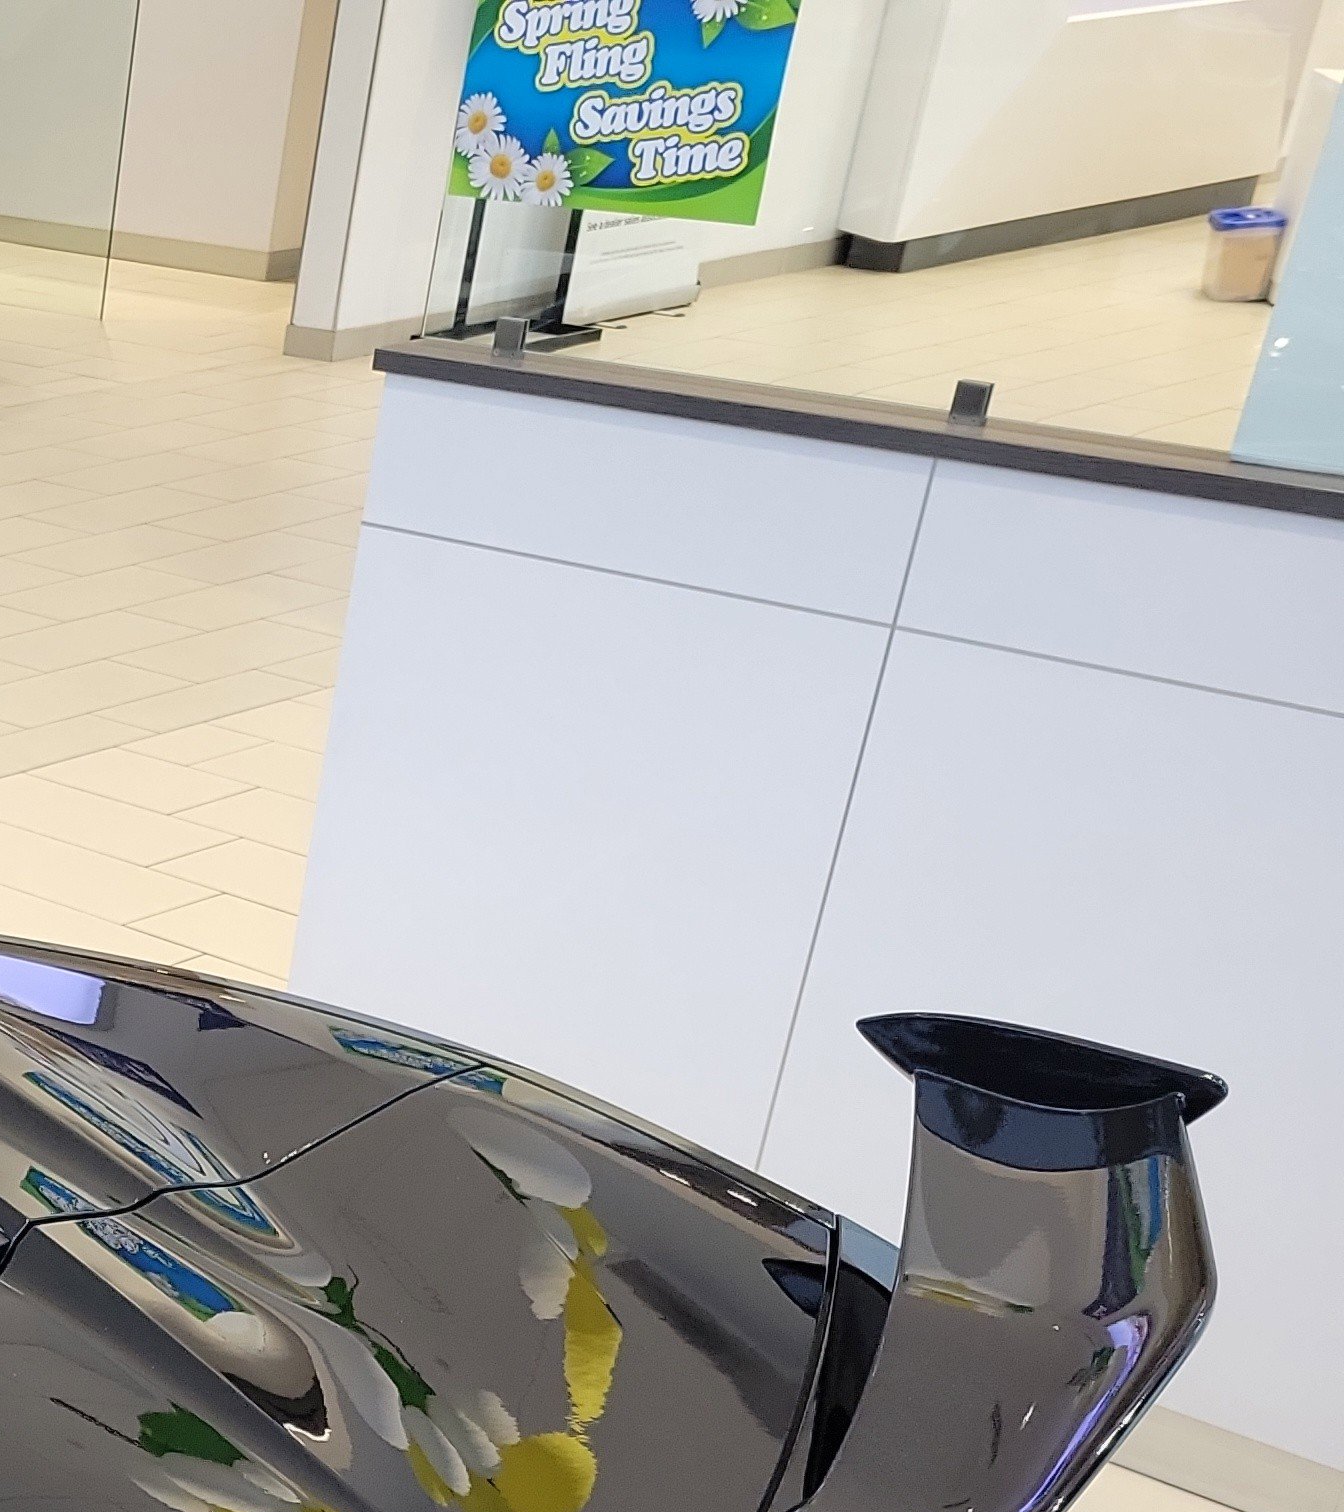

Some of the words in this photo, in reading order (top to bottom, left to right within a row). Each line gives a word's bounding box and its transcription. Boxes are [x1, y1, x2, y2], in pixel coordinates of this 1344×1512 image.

[499, 0, 636, 47] Spring
[540, 36, 648, 86] Fling
[574, 86, 737, 140] Savings
[633, 136, 744, 181] Time
